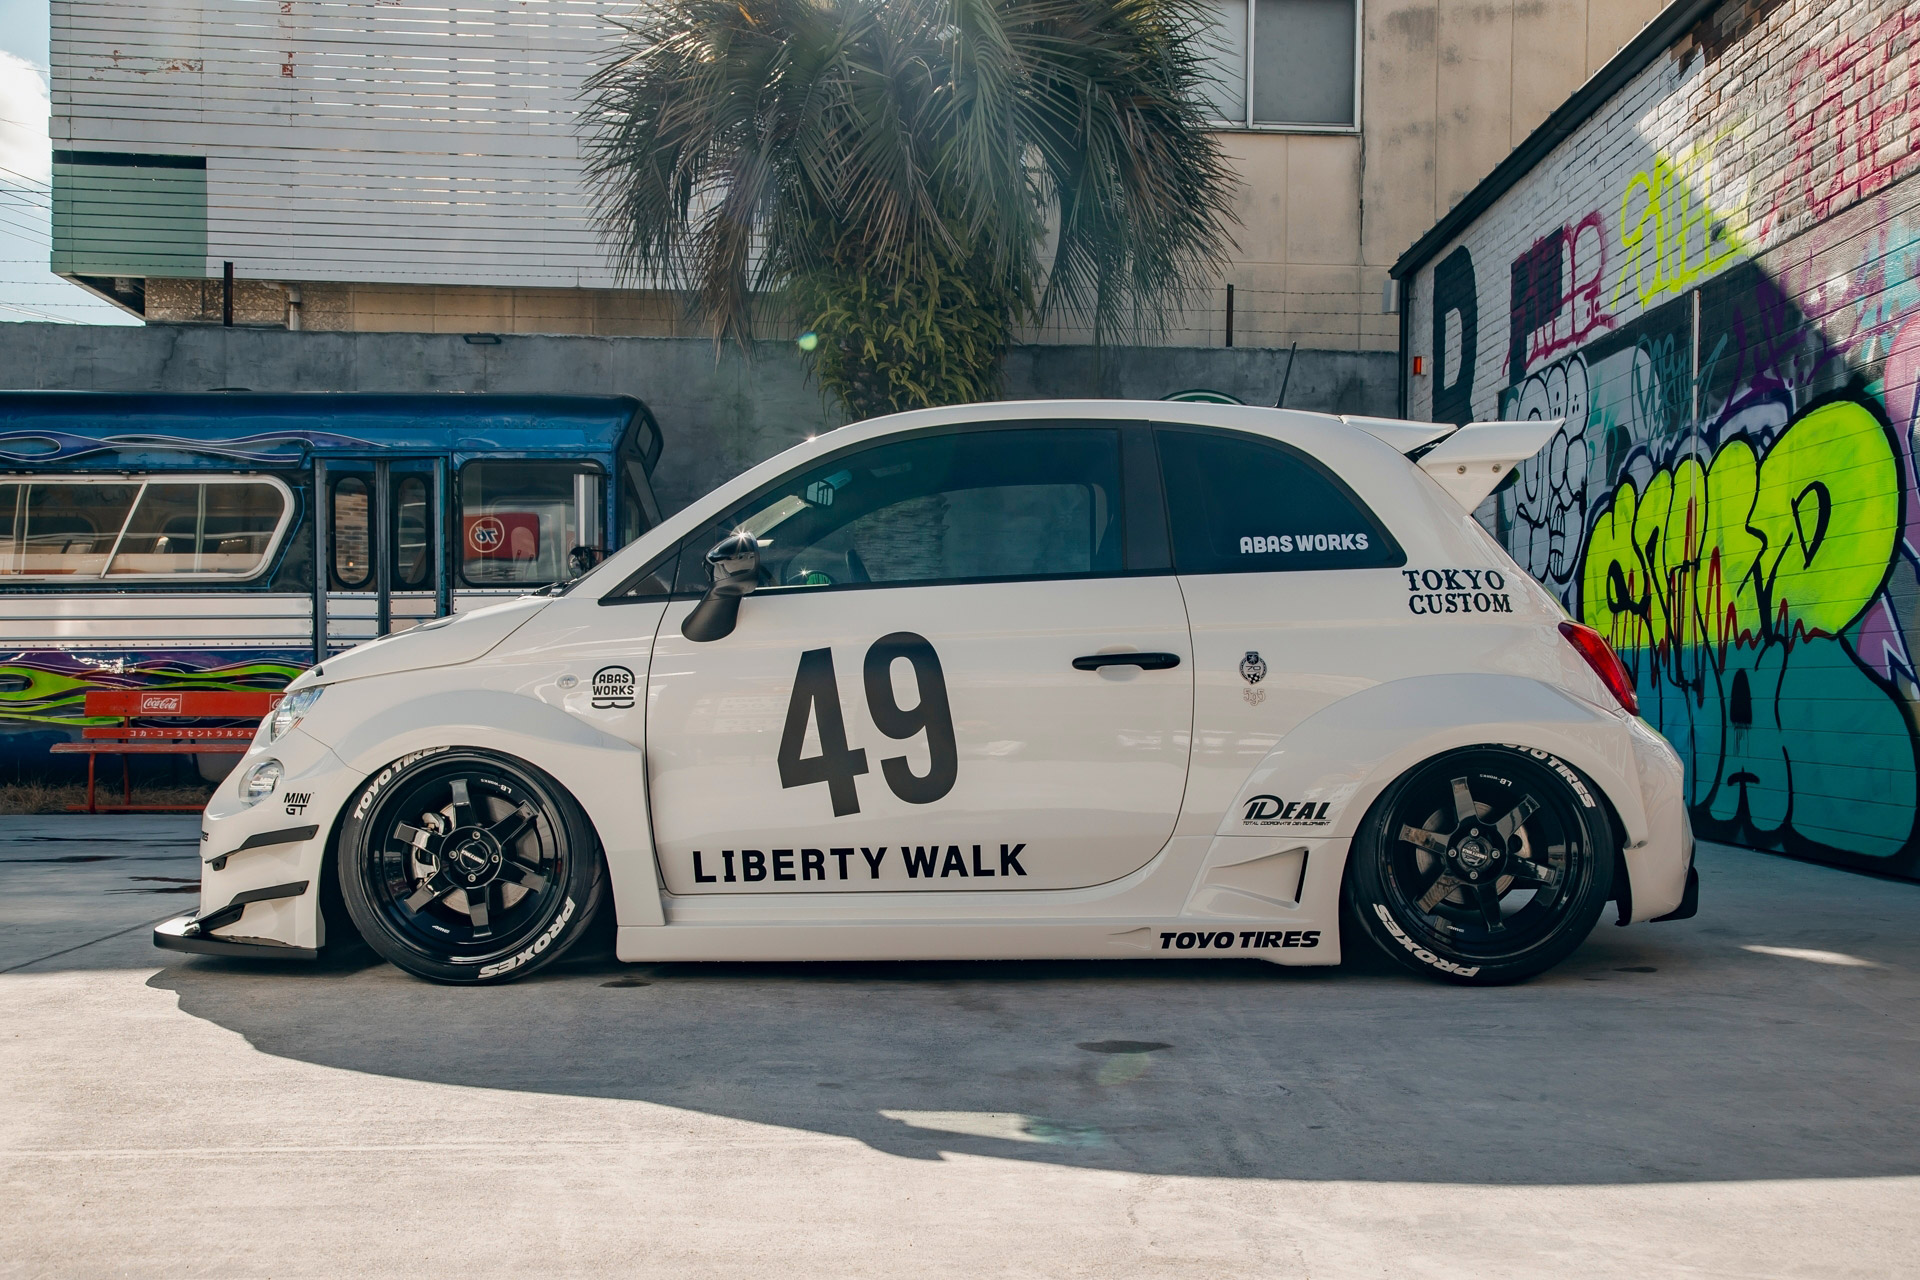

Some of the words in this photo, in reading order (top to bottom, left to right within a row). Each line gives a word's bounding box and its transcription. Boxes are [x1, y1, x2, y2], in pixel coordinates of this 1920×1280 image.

[1240, 535, 1293, 553] ABAS
[1295, 533, 1369, 551] WORKS
[1402, 569, 1505, 591] TOKYO
[1409, 593, 1513, 614] CUSTOM
[599, 674, 629, 683] ABAS
[592, 685, 634, 695] WORKS
[777, 631, 959, 817] 49
[1547, 755, 1596, 808] TIRES
[284, 792, 311, 803] MINI
[353, 768, 392, 820] TOYO
[286, 804, 307, 815] GT
[692, 847, 888, 883] LIBERTY
[901, 843, 1027, 879] WALK
[478, 896, 575, 979] PROXES
[1160, 932, 1235, 949] TOYO
[1239, 931, 1321, 948] TIRES
[1372, 903, 1481, 977] PROXES
